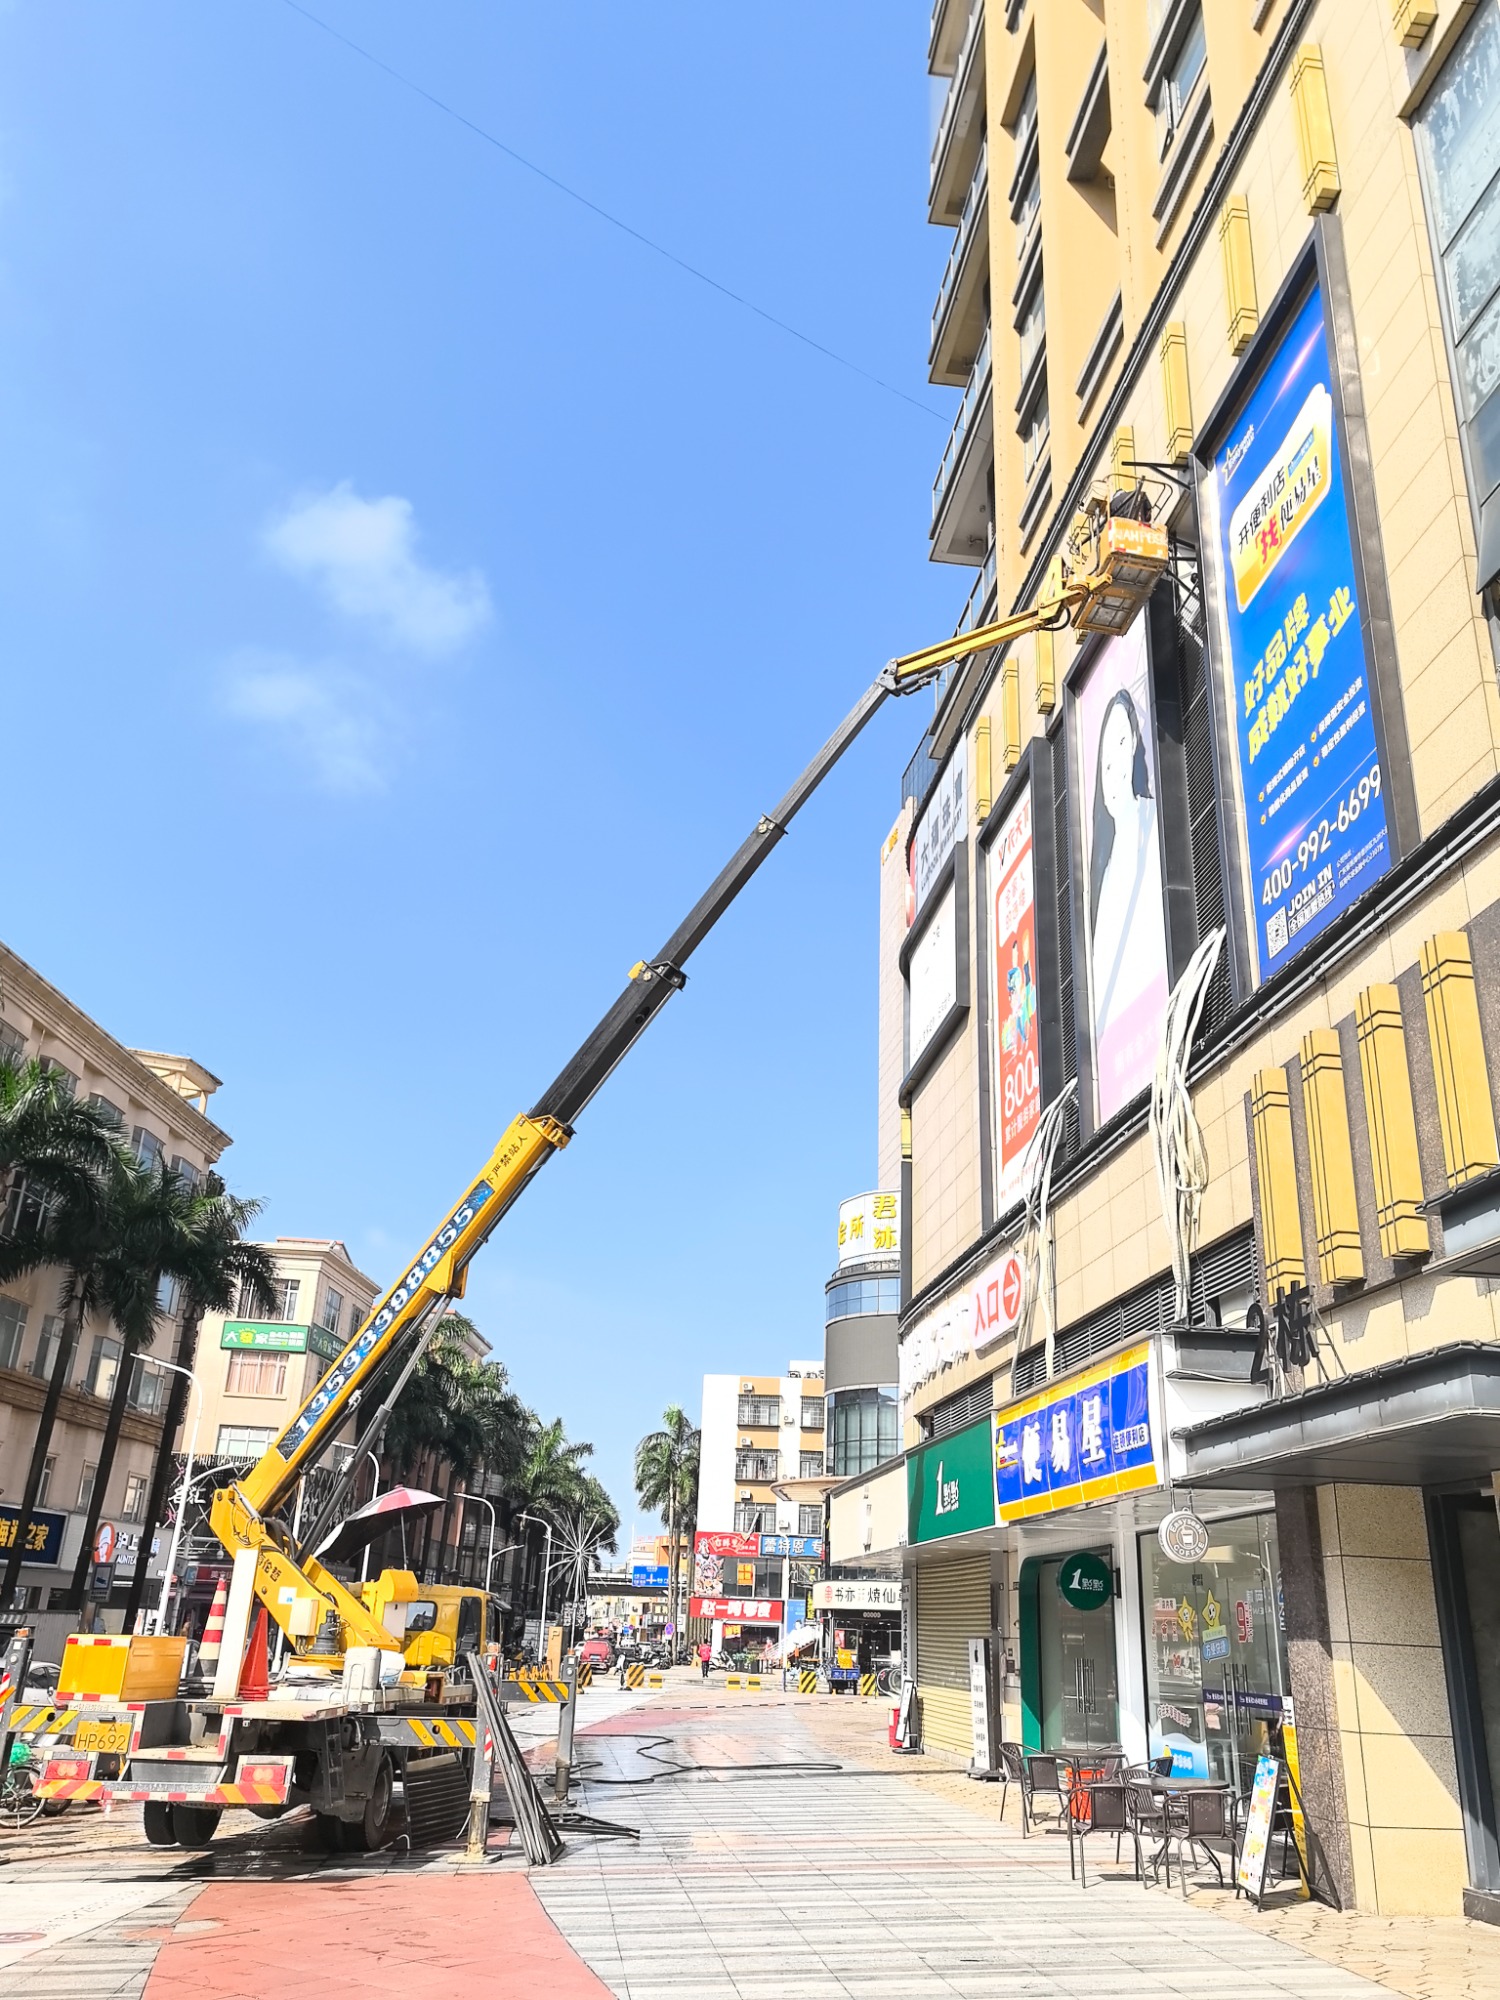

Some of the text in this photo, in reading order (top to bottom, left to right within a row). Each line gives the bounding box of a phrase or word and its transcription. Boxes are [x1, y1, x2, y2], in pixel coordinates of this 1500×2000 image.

[1239, 466, 1286, 554] 开便利店
[1244, 592, 1309, 717] 好品牌
[1249, 586, 1355, 764] 成就好事业
[1262, 764, 1383, 905] 400-992-6699
[1287, 862, 1334, 917] JOIN IN
[974, 1280, 999, 1337] 入口
[1112, 1424, 1147, 1452] 连锁便利店
[1169, 1518, 1205, 1535] Easyseek
[1173, 1541, 1205, 1557] COFFEE
[77, 1733, 126, 1750] HP692
